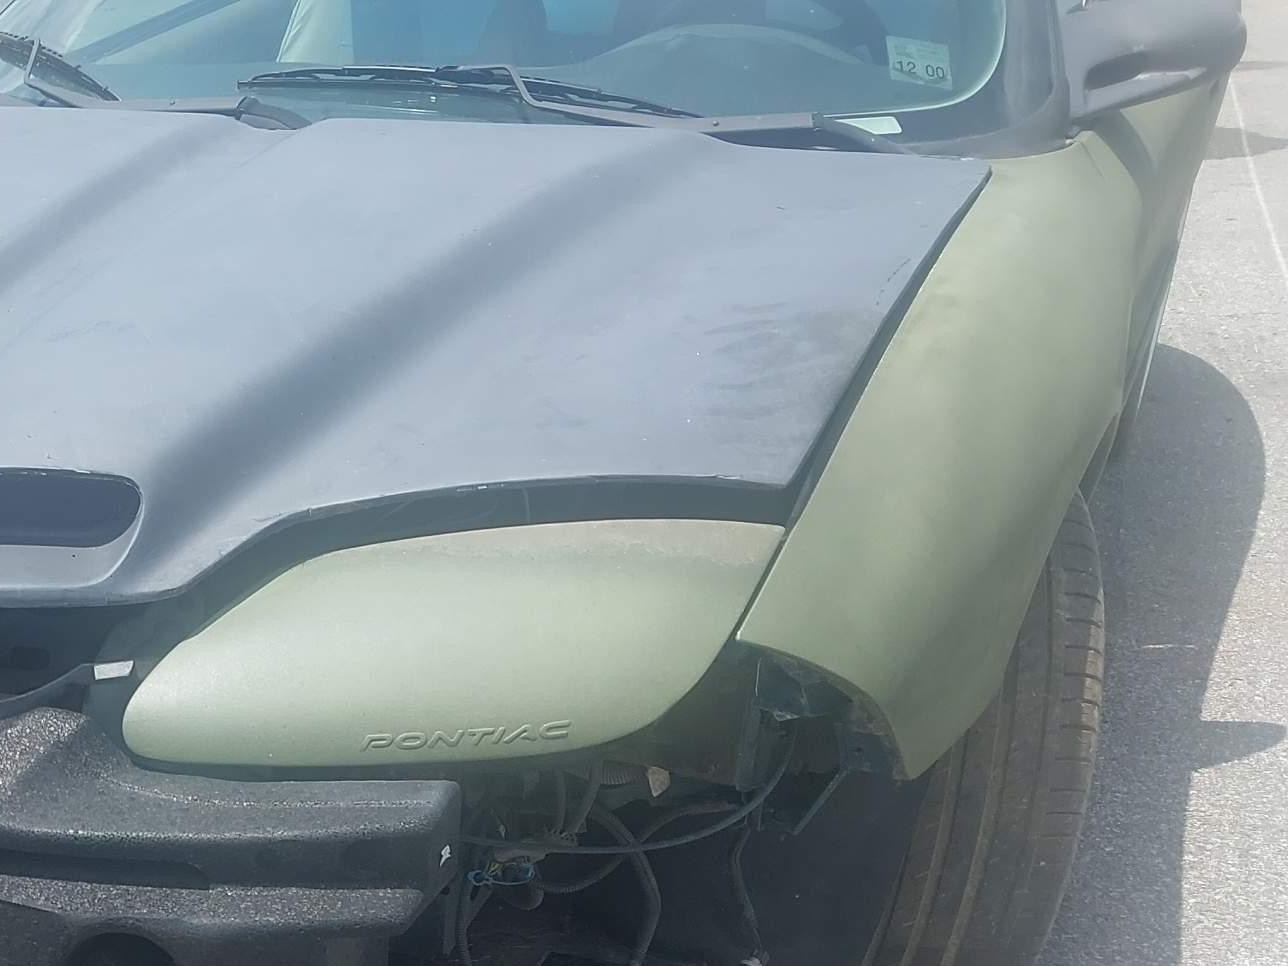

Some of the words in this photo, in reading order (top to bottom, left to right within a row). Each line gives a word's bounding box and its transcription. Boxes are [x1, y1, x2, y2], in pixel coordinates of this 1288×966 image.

[896, 60, 916, 74] 12
[925, 64, 945, 80] 00
[360, 719, 571, 752] PONTIAC
